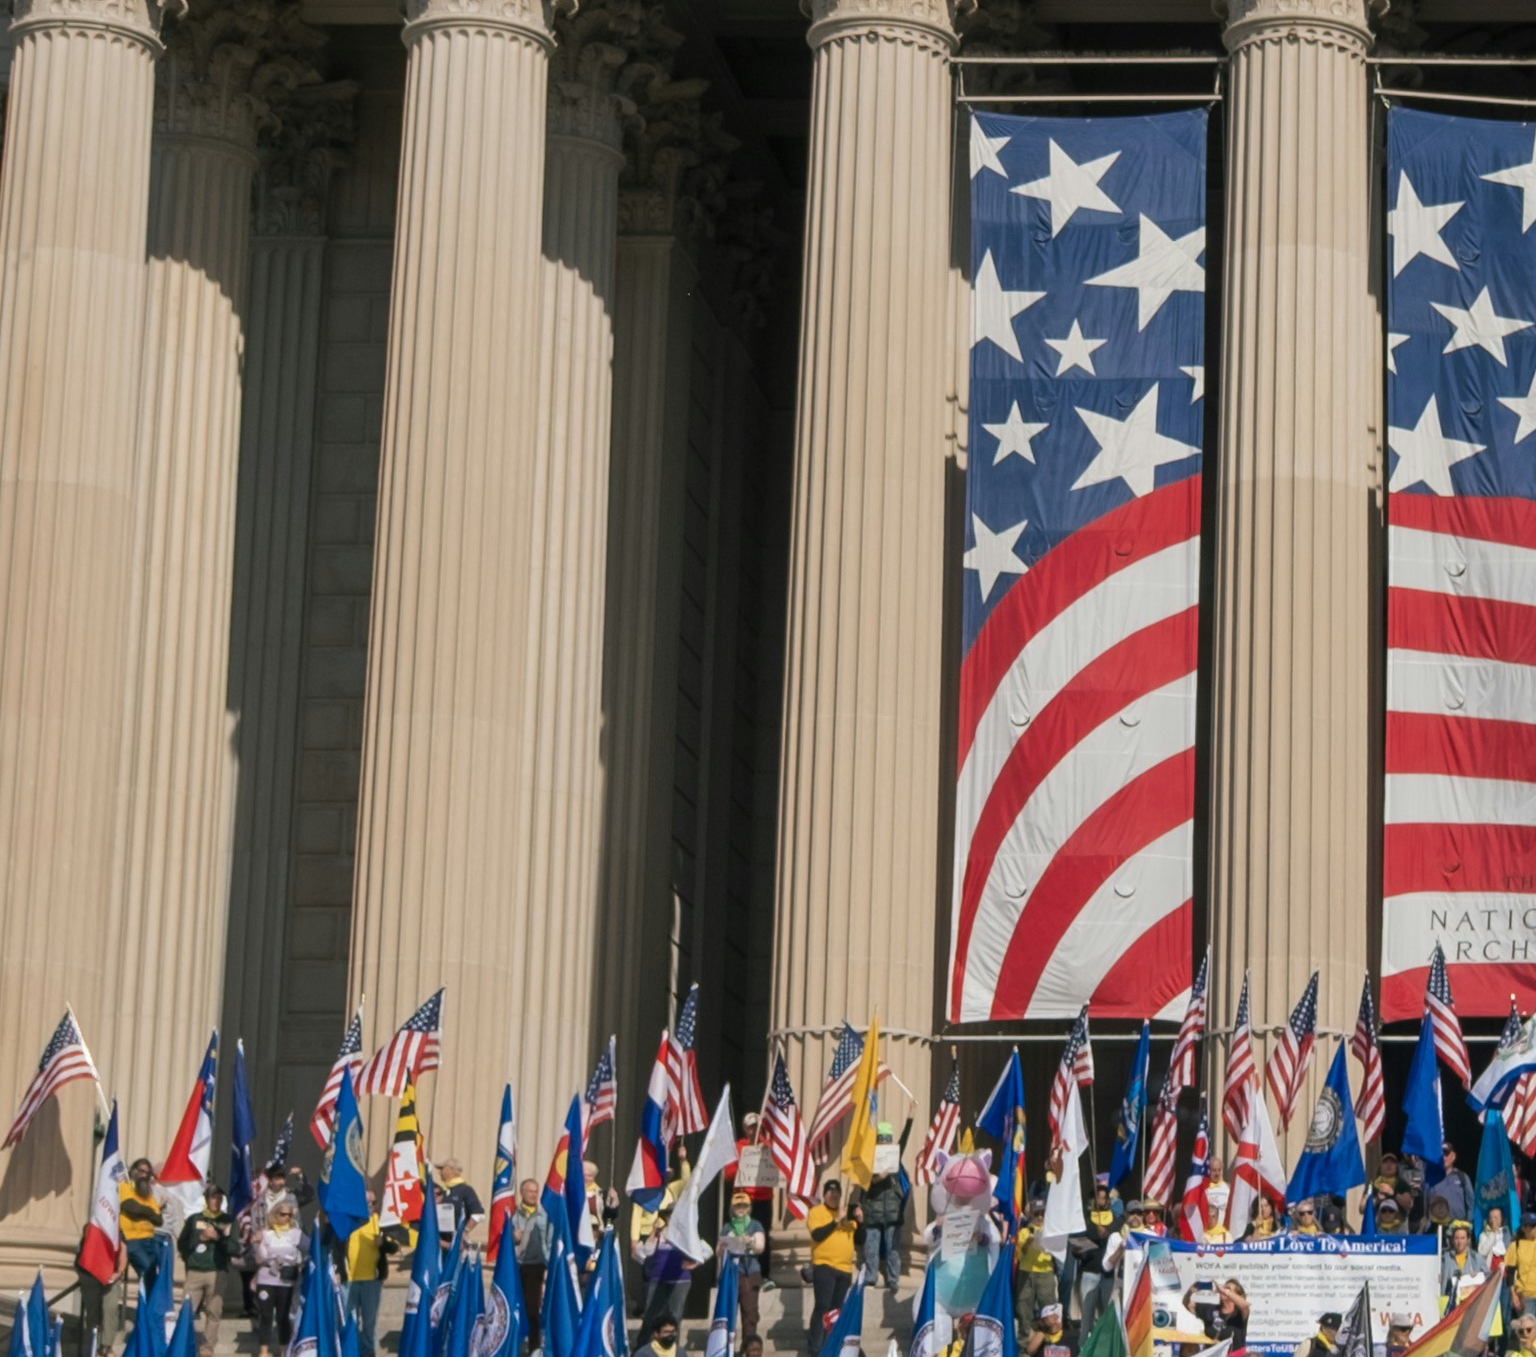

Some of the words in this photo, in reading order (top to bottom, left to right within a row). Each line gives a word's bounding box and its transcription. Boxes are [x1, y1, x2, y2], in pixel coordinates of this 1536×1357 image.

[1241, 1239, 1274, 1252] Your
[1279, 1238, 1314, 1252] Love
[1319, 1238, 1339, 1252] To
[1341, 1238, 1406, 1252] America!
